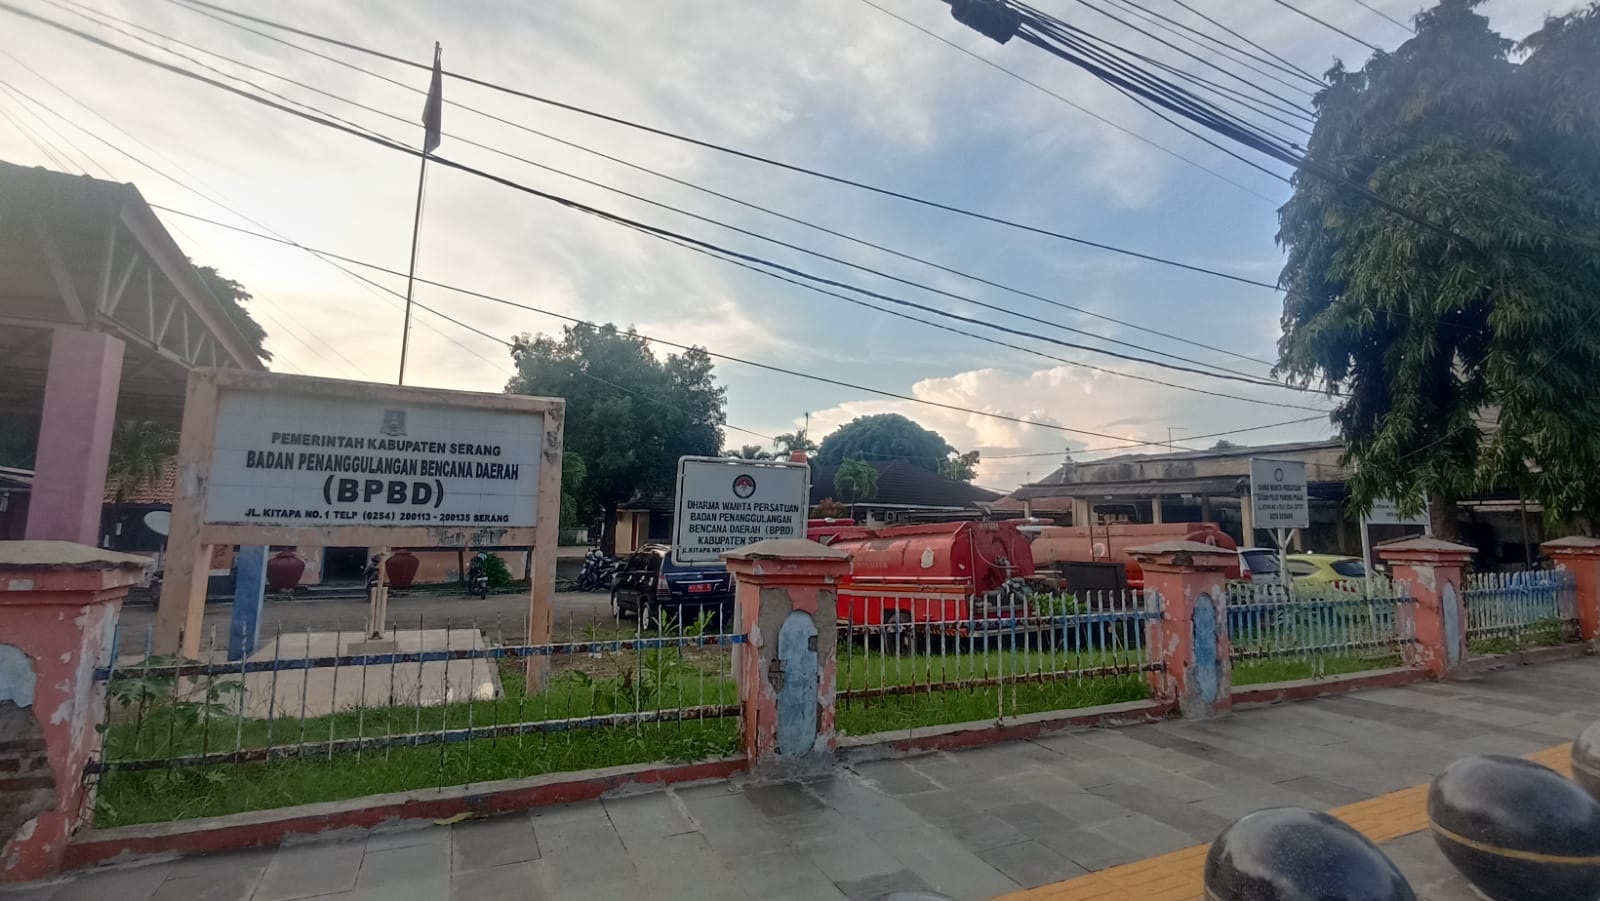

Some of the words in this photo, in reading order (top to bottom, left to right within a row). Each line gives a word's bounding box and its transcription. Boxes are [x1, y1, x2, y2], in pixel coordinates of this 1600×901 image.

[271, 432, 364, 449] PEMERINTAH
[367, 438, 447, 454] KABUPATEN
[449, 443, 501, 457] SERANG
[246, 450, 295, 470] BADAN
[298, 453, 418, 476] PENANGGULANGAN
[420, 459, 473, 478] BENCANA
[475, 462, 519, 480] DAERAH
[323, 474, 445, 508] (BPBD)
[687, 500, 720, 511] DHARMA
[722, 501, 751, 512] WANITA
[754, 503, 799, 513] PERSATUAN
[245, 508, 260, 517] JL.
[263, 509, 302, 518] KITAPA
[333, 511, 358, 519] TELP
[363, 511, 395, 521] (0254)
[400, 512, 431, 521] 200113
[439, 513, 471, 522] 200135
[473, 514, 509, 523] SERANG
[690, 512, 717, 522] BADAN
[719, 513, 792, 524] PENANGGULANGAN
[689, 524, 727, 533] BENCANA
[730, 525, 761, 534] DAERAH
[765, 526, 794, 536] (BPBD)
[698, 536, 746, 545] KABUPATEN
